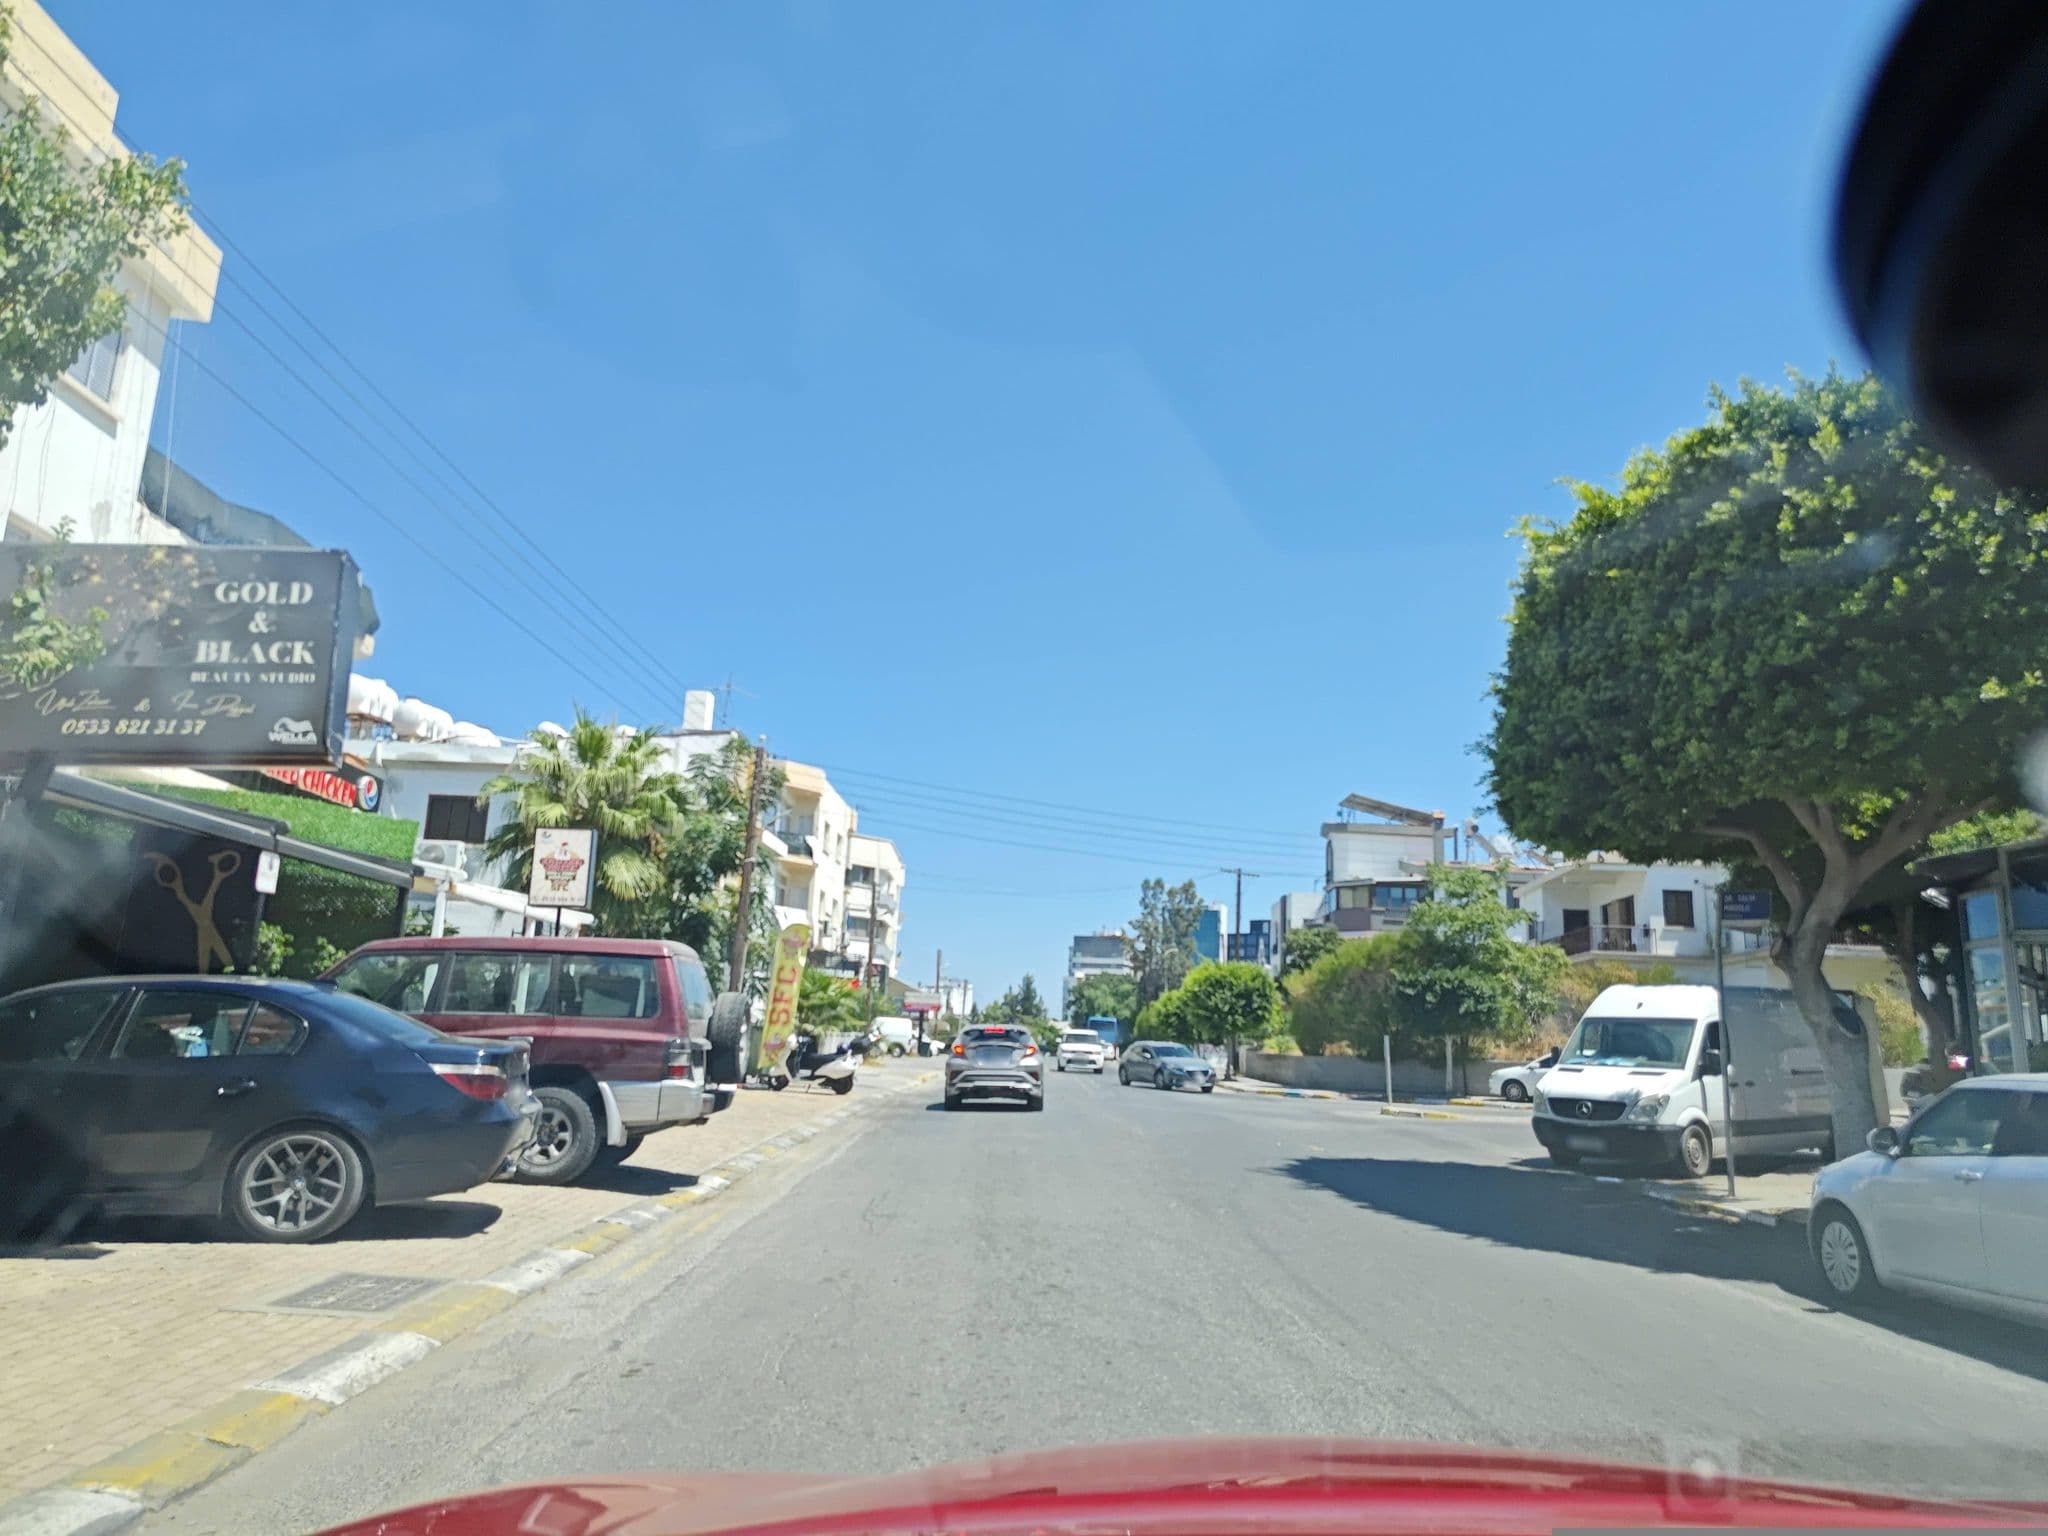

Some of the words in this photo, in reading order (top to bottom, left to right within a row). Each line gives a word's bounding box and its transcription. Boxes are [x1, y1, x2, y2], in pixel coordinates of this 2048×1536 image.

[215, 581, 313, 604] GOLD
[248, 610, 269, 633] &
[195, 639, 315, 664] BLACK
[190, 671, 251, 683] BEAUTY
[260, 671, 316, 683] STUDIO
[61, 718, 111, 735] 0533
[115, 718, 151, 735] 821
[154, 718, 178, 735] 31
[180, 718, 207, 736] 37
[768, 966, 798, 1026] SFC
